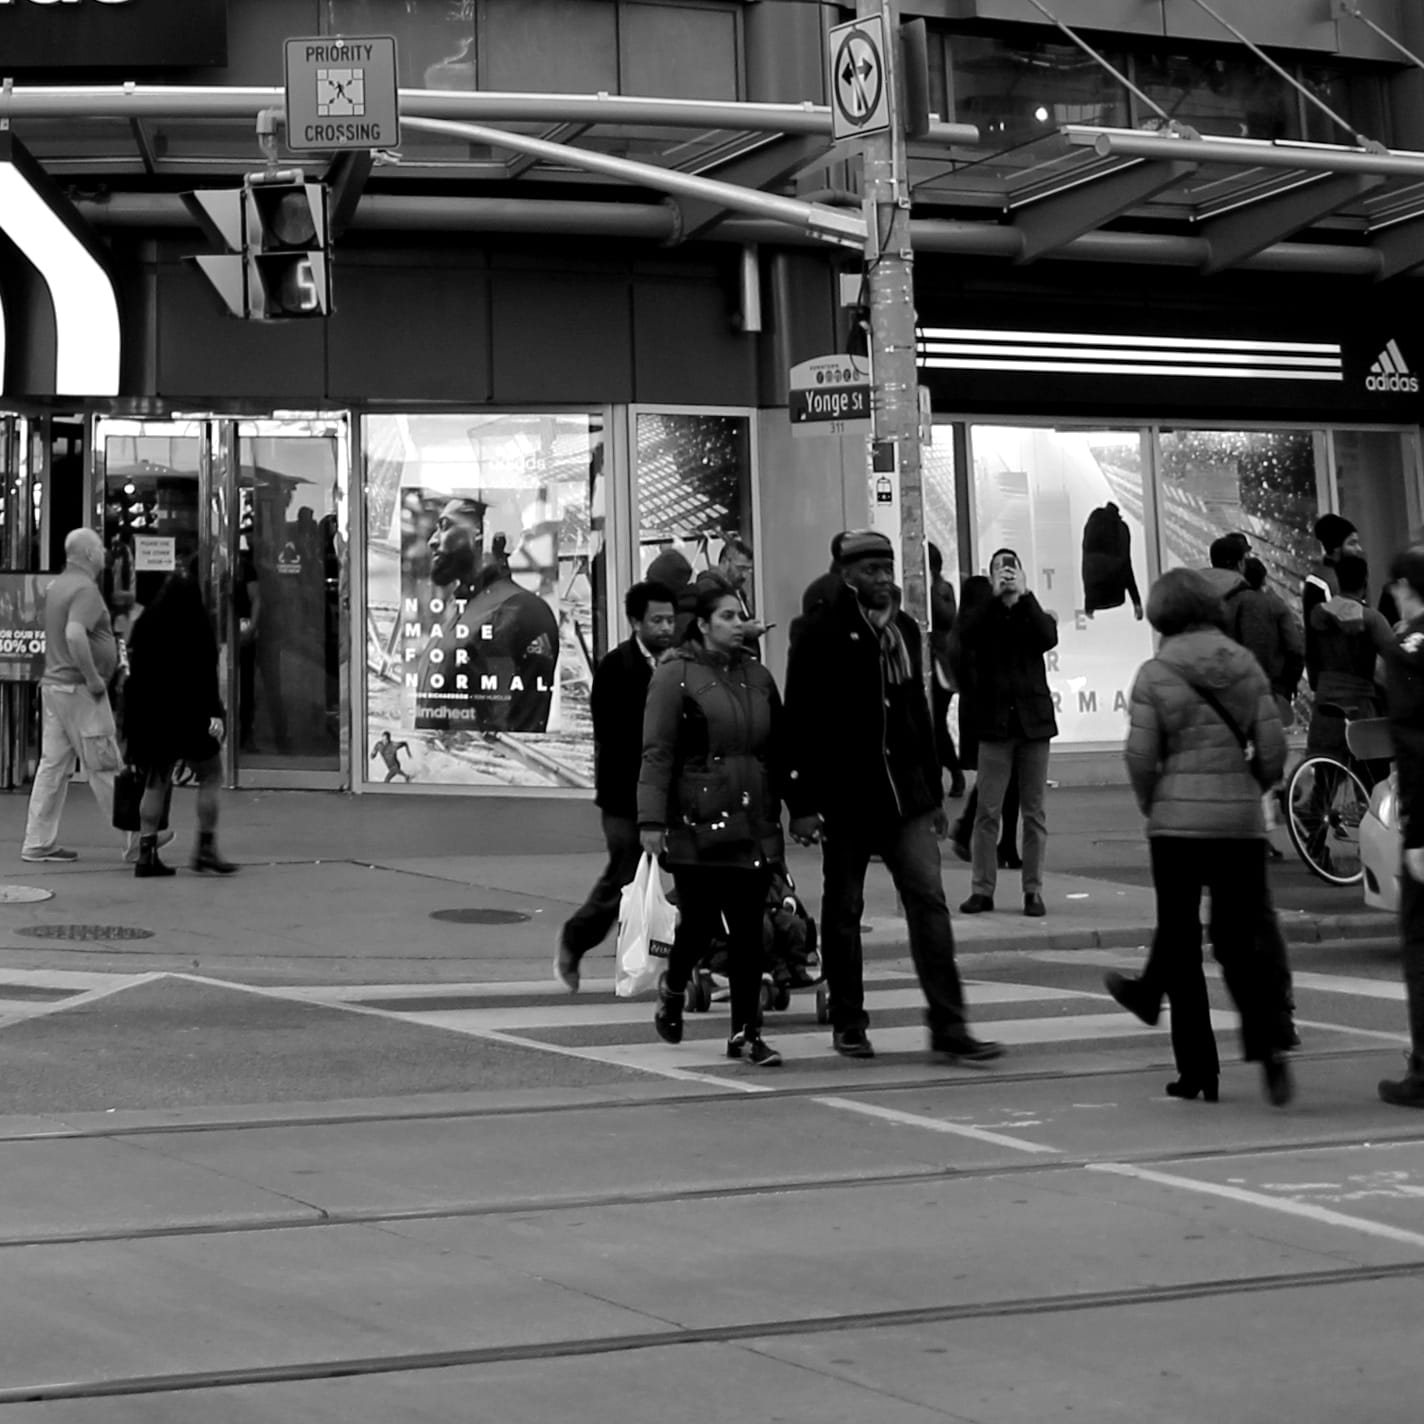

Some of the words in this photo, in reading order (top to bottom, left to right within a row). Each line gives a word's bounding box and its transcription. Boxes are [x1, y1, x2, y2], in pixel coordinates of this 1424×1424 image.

[305, 44, 373, 63] PRIORITY
[305, 123, 381, 143] CROSSING
[296, 260, 319, 310] 5
[1365, 372, 1419, 393] adidas
[805, 390, 849, 417] Yonge
[851, 391, 863, 410] St
[405, 597, 468, 614] NOT
[405, 622, 494, 640] MADE
[405, 648, 469, 665] FOR
[405, 673, 555, 692] NORMAL.
